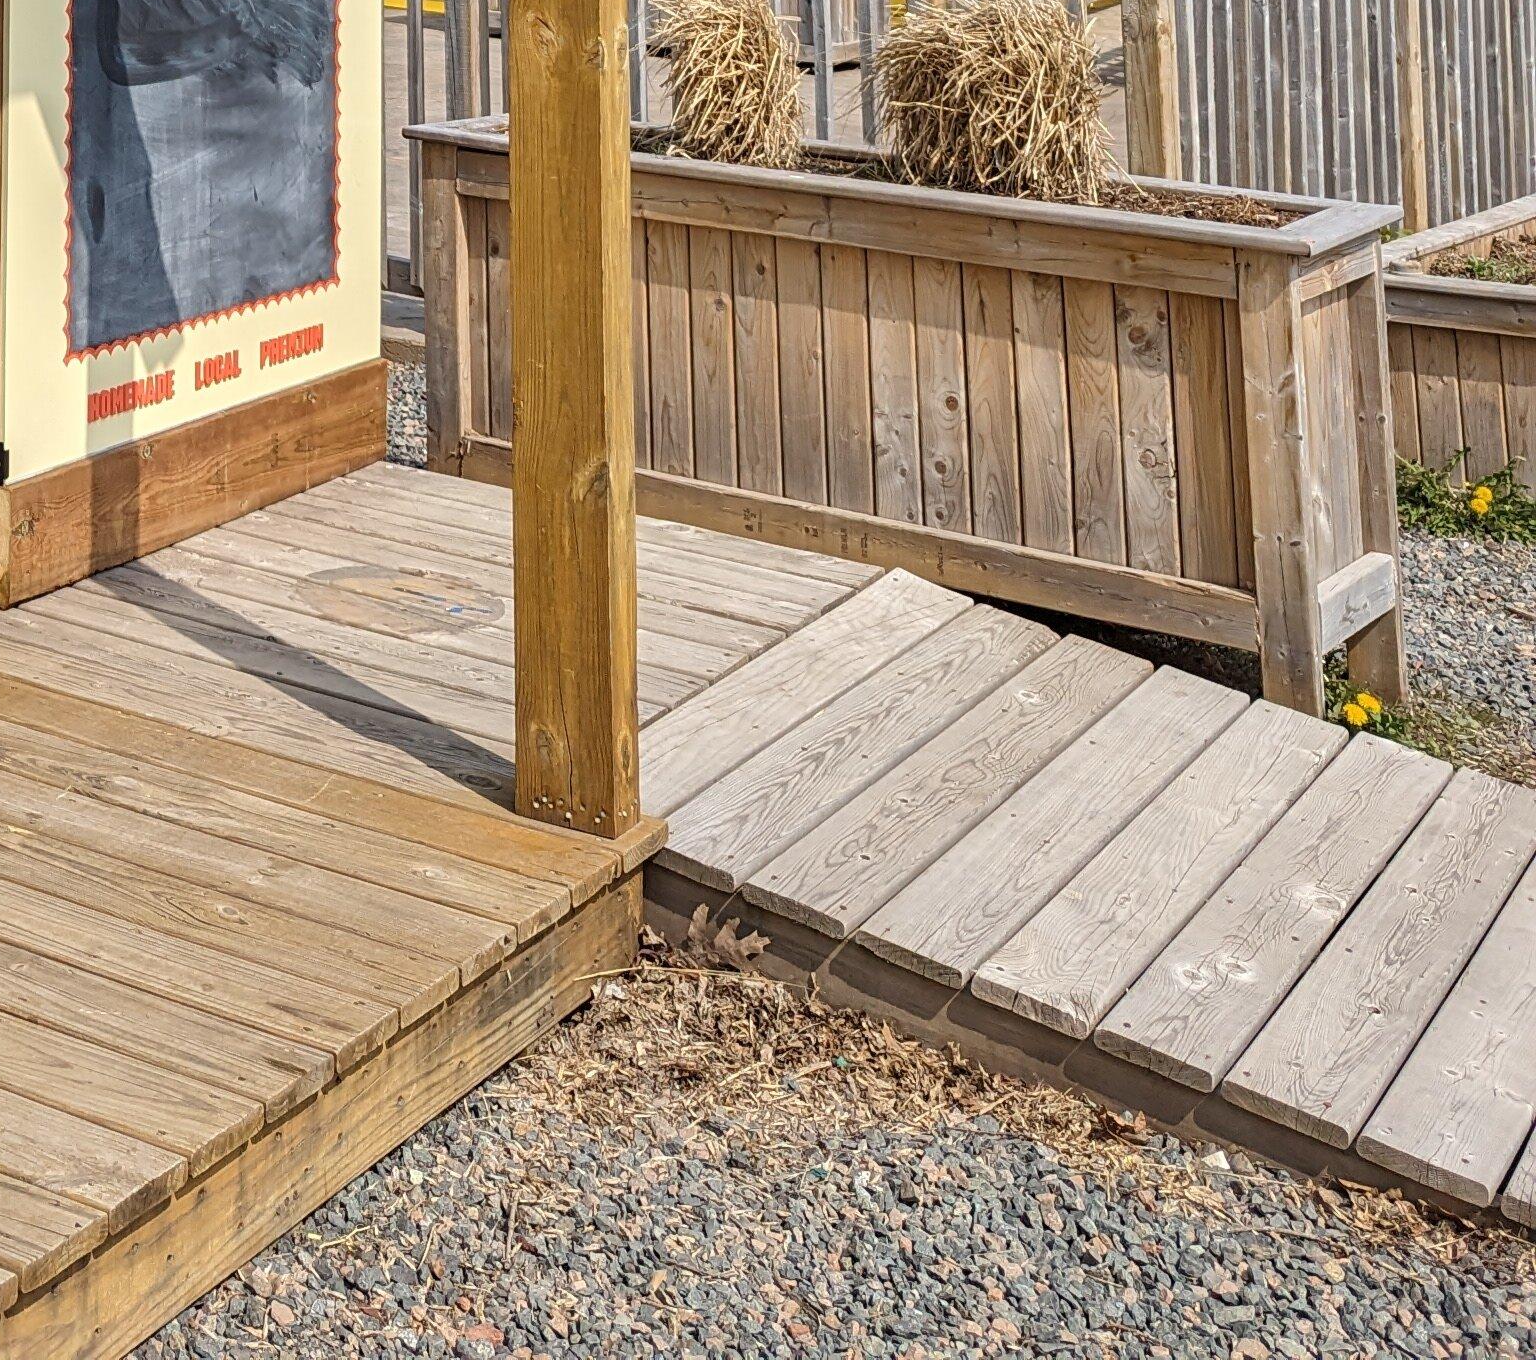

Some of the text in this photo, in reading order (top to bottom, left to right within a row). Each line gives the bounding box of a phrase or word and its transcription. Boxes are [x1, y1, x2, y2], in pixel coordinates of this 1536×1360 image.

[87, 323, 324, 423] HOMEMADE LOCAL PREMIUM
